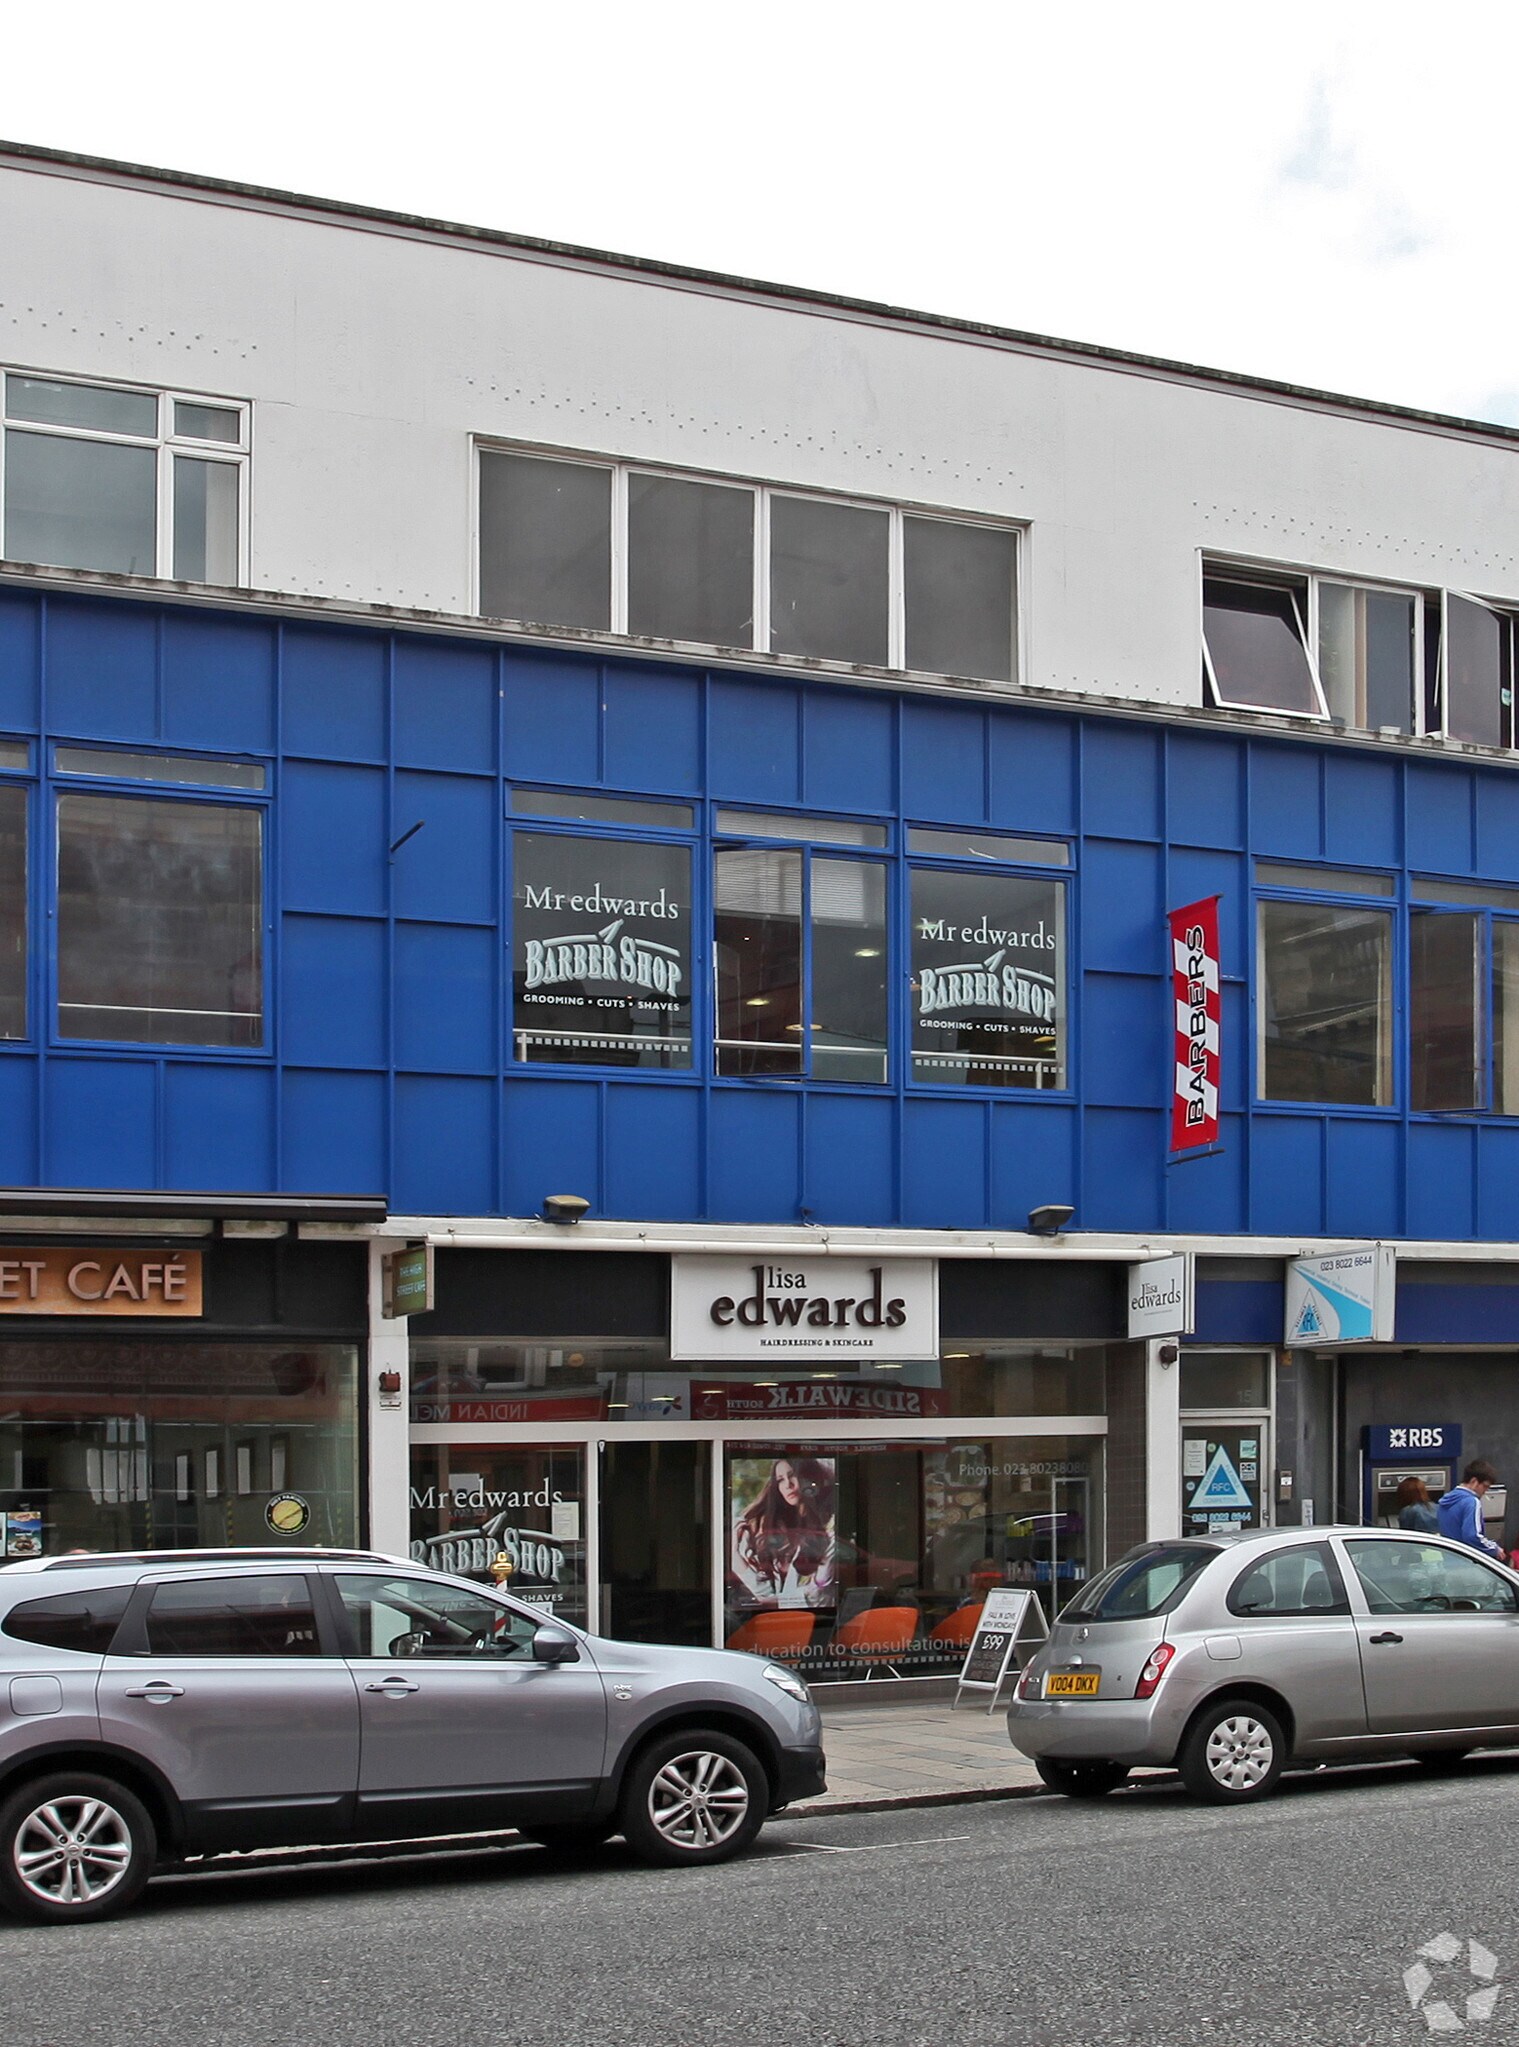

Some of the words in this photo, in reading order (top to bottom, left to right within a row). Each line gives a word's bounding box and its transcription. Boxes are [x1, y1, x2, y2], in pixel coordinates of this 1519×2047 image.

[524, 884, 568, 911] Mr
[570, 882, 679, 919] edwards
[920, 917, 957, 943] Mr
[961, 915, 1056, 951] edwards
[524, 938, 619, 990] BARBER
[620, 935, 683, 999] SHOP
[523, 994, 584, 1007] GROOMING
[597, 998, 625, 1009] CUTS
[638, 1001, 680, 1012] SHAVES
[919, 967, 1001, 1015] BARBER
[1002, 964, 1057, 1023] SHOP
[919, 1019, 973, 1031] GROOMING
[983, 1023, 1009, 1033] CUTS
[1019, 1025, 1056, 1036] SHAVES
[1184, 924, 1206, 1128] BARBERS
[67, 1254, 187, 1301] CAFÉ
[768, 1266, 806, 1289] lisa
[1320, 1261, 1334, 1272] 023
[1335, 1258, 1353, 1270] 8022
[710, 1264, 907, 1328] edwards
[1131, 1278, 1181, 1310] edwards
[760, 1339, 823, 1347] HAIRDRESSING
[832, 1339, 874, 1347] SKINCARE
[1409, 1428, 1443, 1448] RBS
[410, 1487, 448, 1509] Mr
[454, 1477, 562, 1508] edwards
[503, 1527, 566, 1584] SHOP
[521, 1593, 564, 1602] SHAVES
[828, 1641, 846, 1656] to
[851, 1635, 954, 1655] consultation
[981, 1634, 1005, 1651] £99
[1074, 1675, 1096, 1692] DKX
